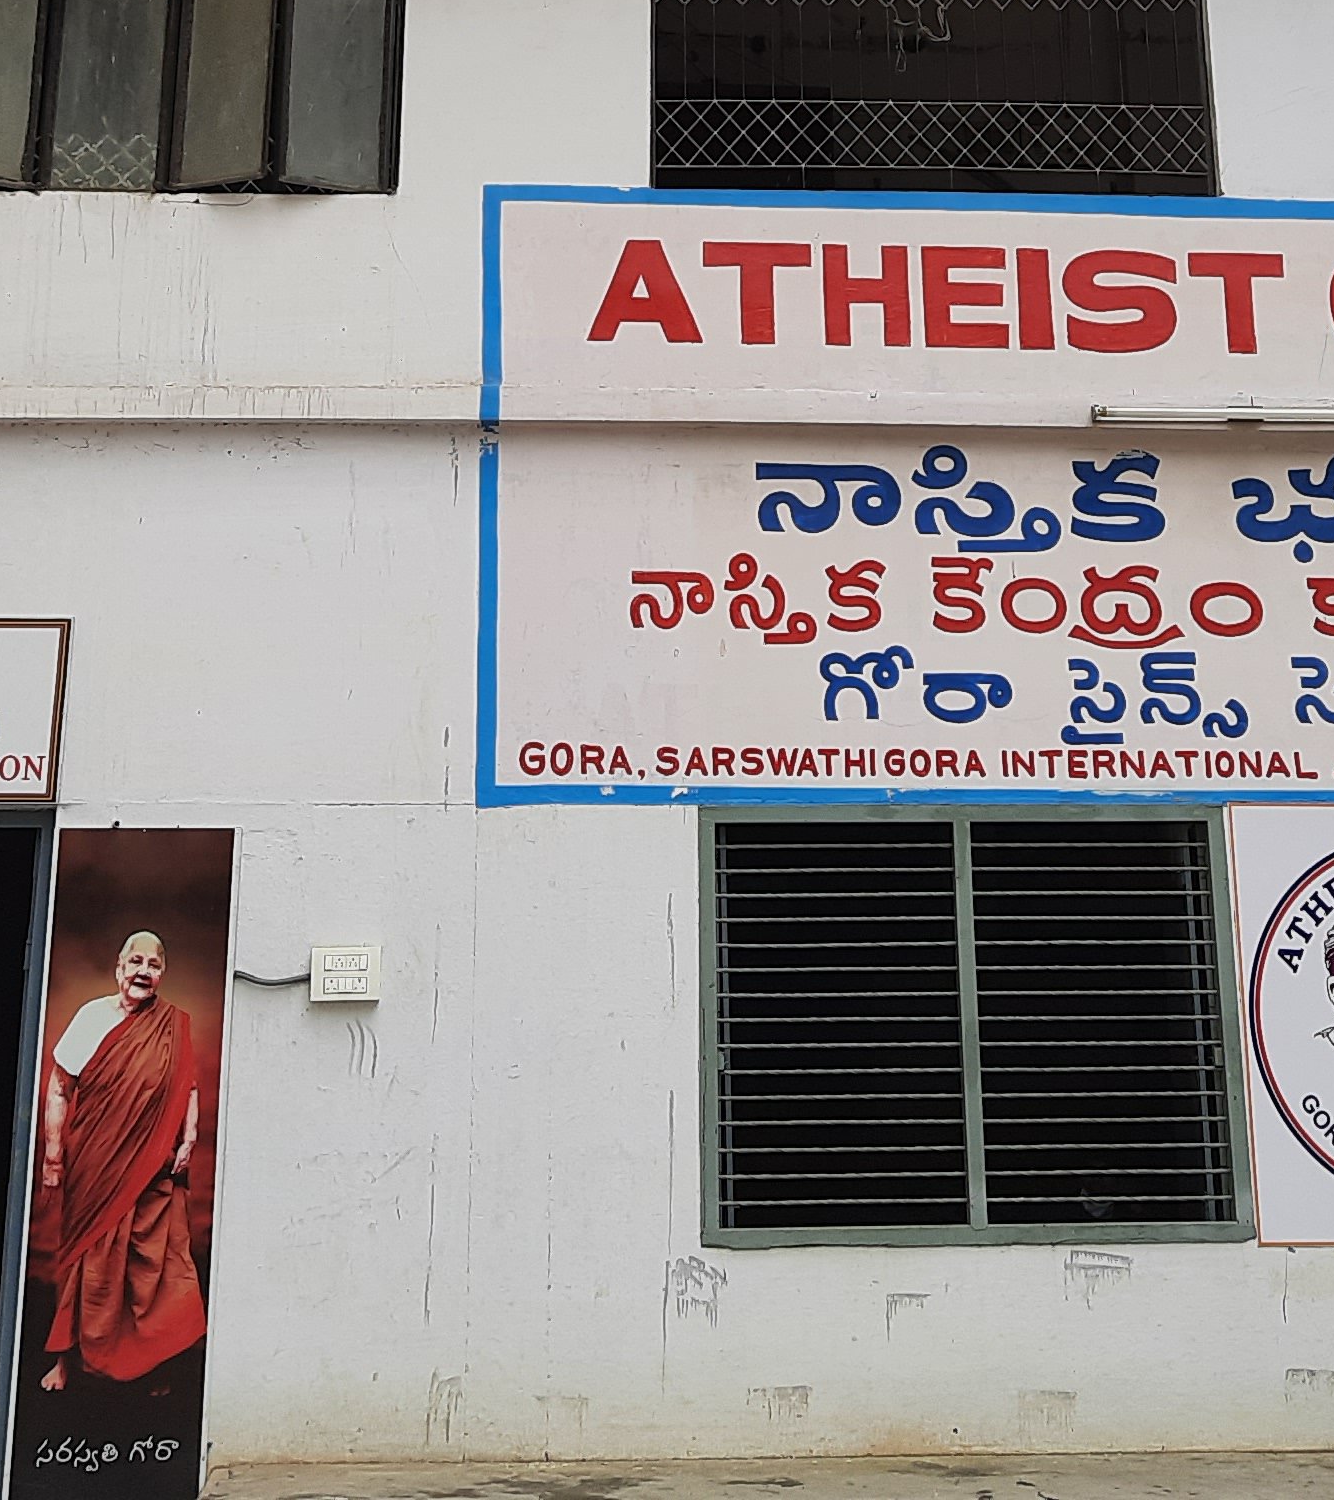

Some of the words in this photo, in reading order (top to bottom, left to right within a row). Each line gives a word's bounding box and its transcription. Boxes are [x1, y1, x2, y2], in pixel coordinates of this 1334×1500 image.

[586, 239, 1286, 355] ATHEIST
[755, 444, 1166, 553] నాస్తిక
[629, 552, 887, 645] నాస్తిక
[931, 556, 1264, 650] కేంద్రం
[819, 645, 1014, 723] గోరా
[1060, 651, 1249, 745] సైన్స్
[518, 742, 646, 781] GORA,
[1001, 749, 1318, 780] INTERNATIONAL
[35, 1436, 119, 1472] సరస్వతి
[128, 1434, 180, 1462] గోరా
